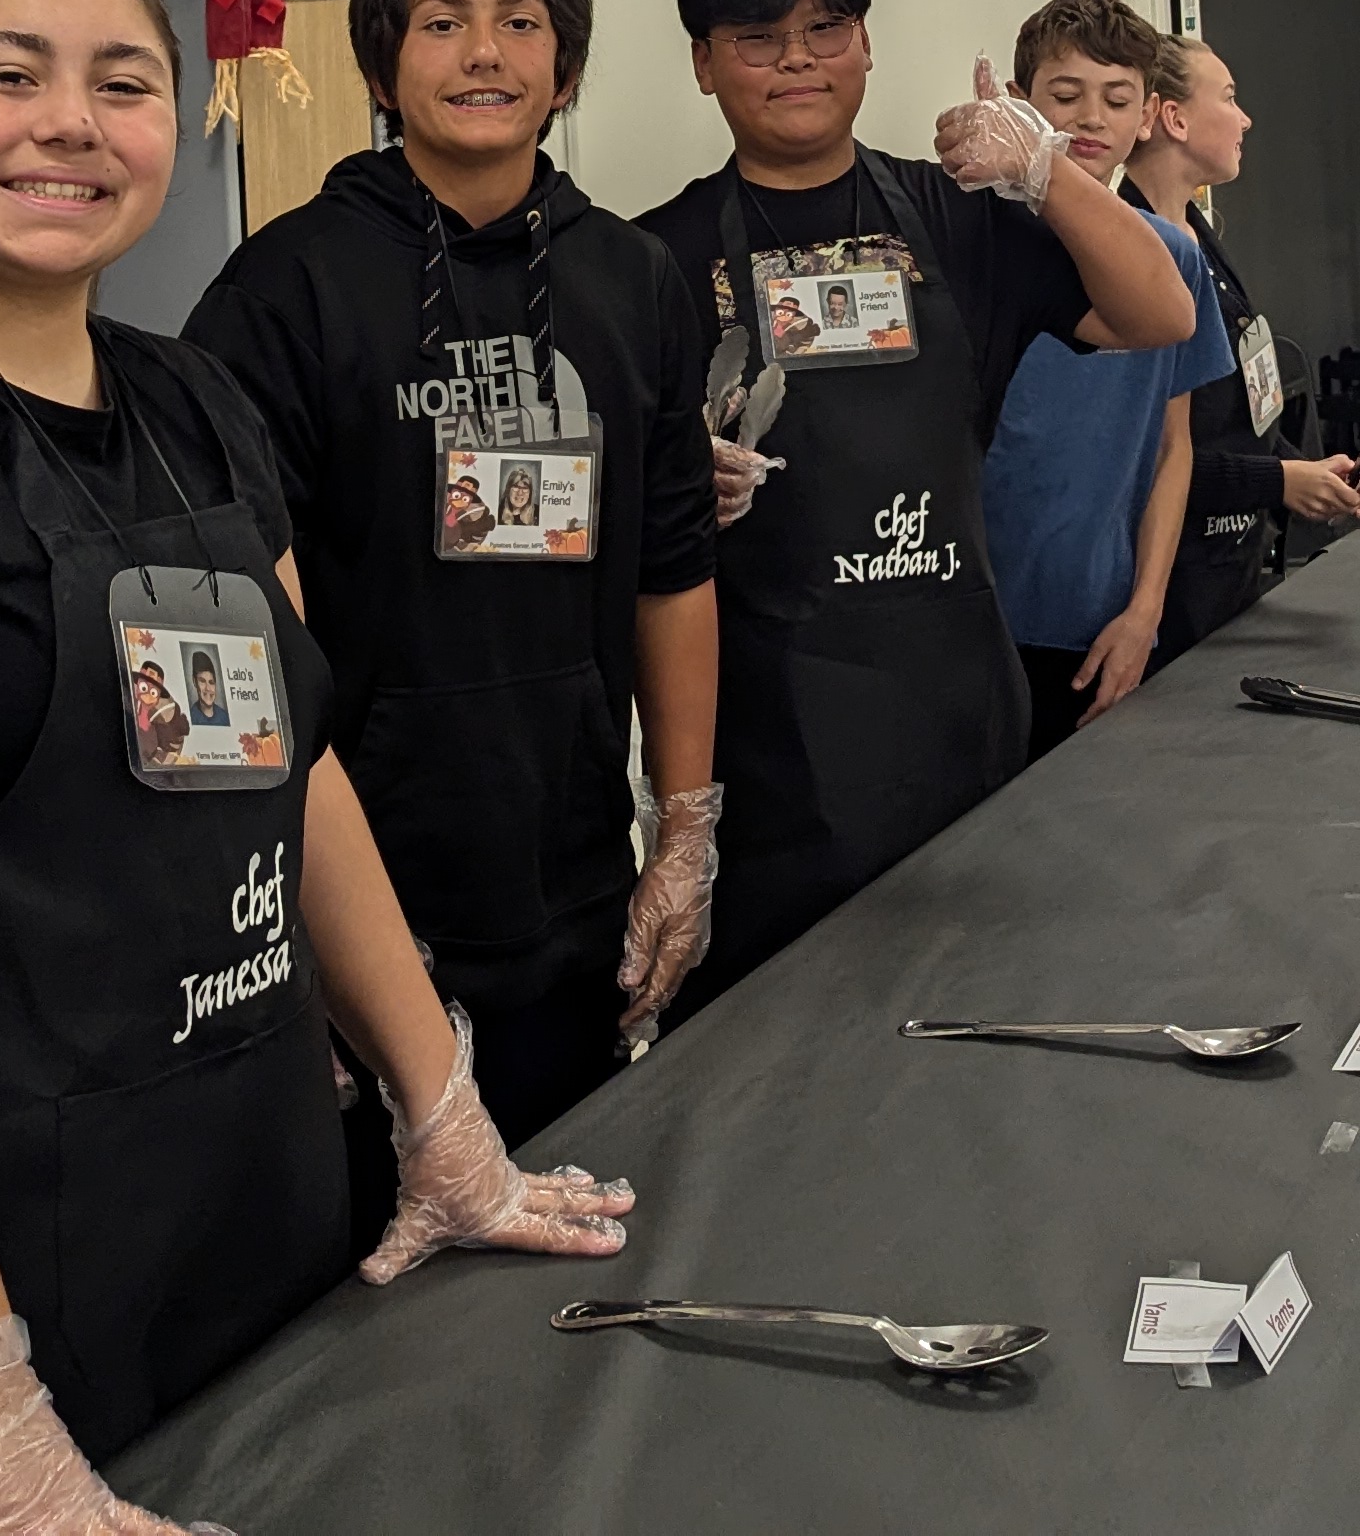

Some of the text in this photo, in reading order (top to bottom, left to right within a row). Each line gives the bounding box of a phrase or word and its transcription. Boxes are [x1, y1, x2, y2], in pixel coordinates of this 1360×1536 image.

[859, 291, 898, 302] Jayden's
[860, 302, 889, 312] Friend
[444, 336, 513, 376] THE
[396, 372, 518, 420] NORTH
[435, 410, 521, 454] FACE
[542, 480, 575, 493] Emily's
[542, 495, 571, 506] Friend
[833, 534, 961, 583] Nathan J.
[227, 668, 253, 681] Lalo's
[230, 687, 259, 701] Friend
[173, 940, 292, 1044] Janessa
[1141, 1301, 1168, 1335] Yams
[1265, 1298, 1295, 1339] Yams
